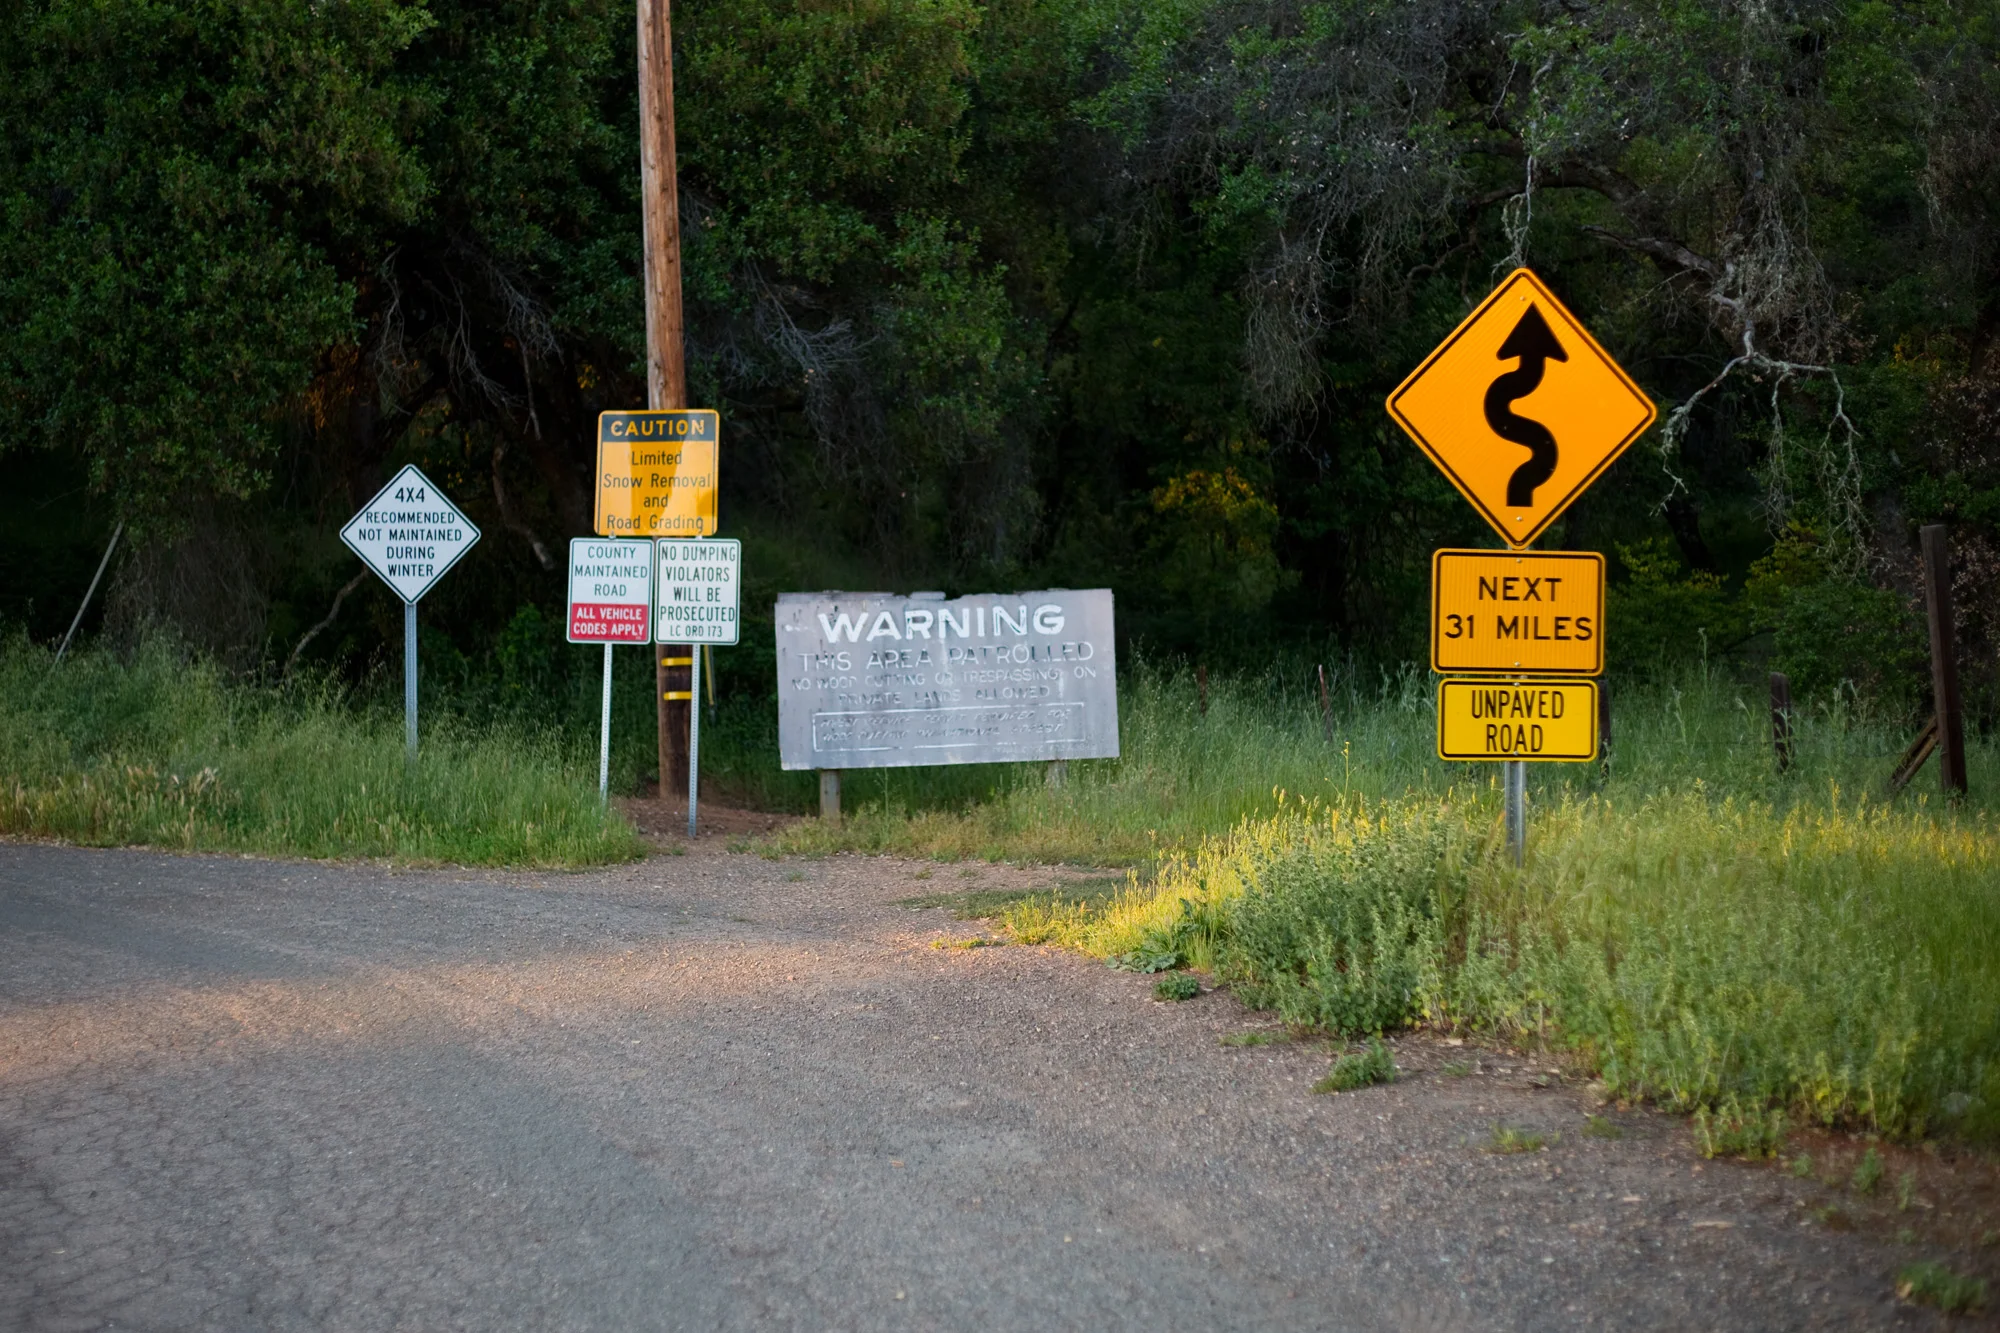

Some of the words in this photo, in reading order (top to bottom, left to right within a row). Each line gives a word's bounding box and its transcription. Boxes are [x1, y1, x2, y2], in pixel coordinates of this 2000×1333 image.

[611, 420, 704, 436] CAUTION
[632, 451, 682, 466] Limited
[604, 474, 642, 488] Snow
[651, 473, 710, 488] Removal
[395, 487, 425, 502] 4X4
[644, 494, 668, 508] and
[366, 512, 455, 524] RECOMMENDED
[607, 514, 640, 529] Road
[650, 514, 704, 533] Grading
[358, 528, 382, 540] NOT
[389, 528, 462, 541] MAINTAINED
[386, 546, 434, 559] DURING
[588, 546, 636, 558] COUNTY
[661, 546, 676, 560] NO
[683, 546, 736, 562] DUMPING
[388, 564, 434, 576] WINTER
[574, 566, 648, 578] MAINTAINED
[666, 566, 730, 582] VIOLATORS
[594, 584, 626, 596] ROAD
[674, 587, 700, 602] WILL
[707, 588, 720, 602] BE
[1479, 576, 1562, 601] NEXT
[576, 607, 596, 620] ALL
[600, 608, 642, 620] VEHICLE
[660, 606, 734, 622] PROSECUTED
[574, 622, 606, 634] CODES
[611, 624, 644, 636] APPLY
[670, 625, 680, 636] LC
[686, 626, 704, 637] ORD
[708, 626, 722, 637] 173
[818, 604, 1065, 643] WARNING
[1444, 614, 1474, 639] 31
[1497, 616, 1593, 641] MILES
[797, 651, 852, 672] THIS
[866, 648, 933, 670] AREA
[950, 641, 1094, 665] PATROLLED
[792, 678, 812, 691] NO
[963, 668, 1060, 683] TRESPASSING
[1074, 666, 1096, 678] ON
[1472, 690, 1564, 719] UNPAVED
[1486, 724, 1544, 752] ROAD
